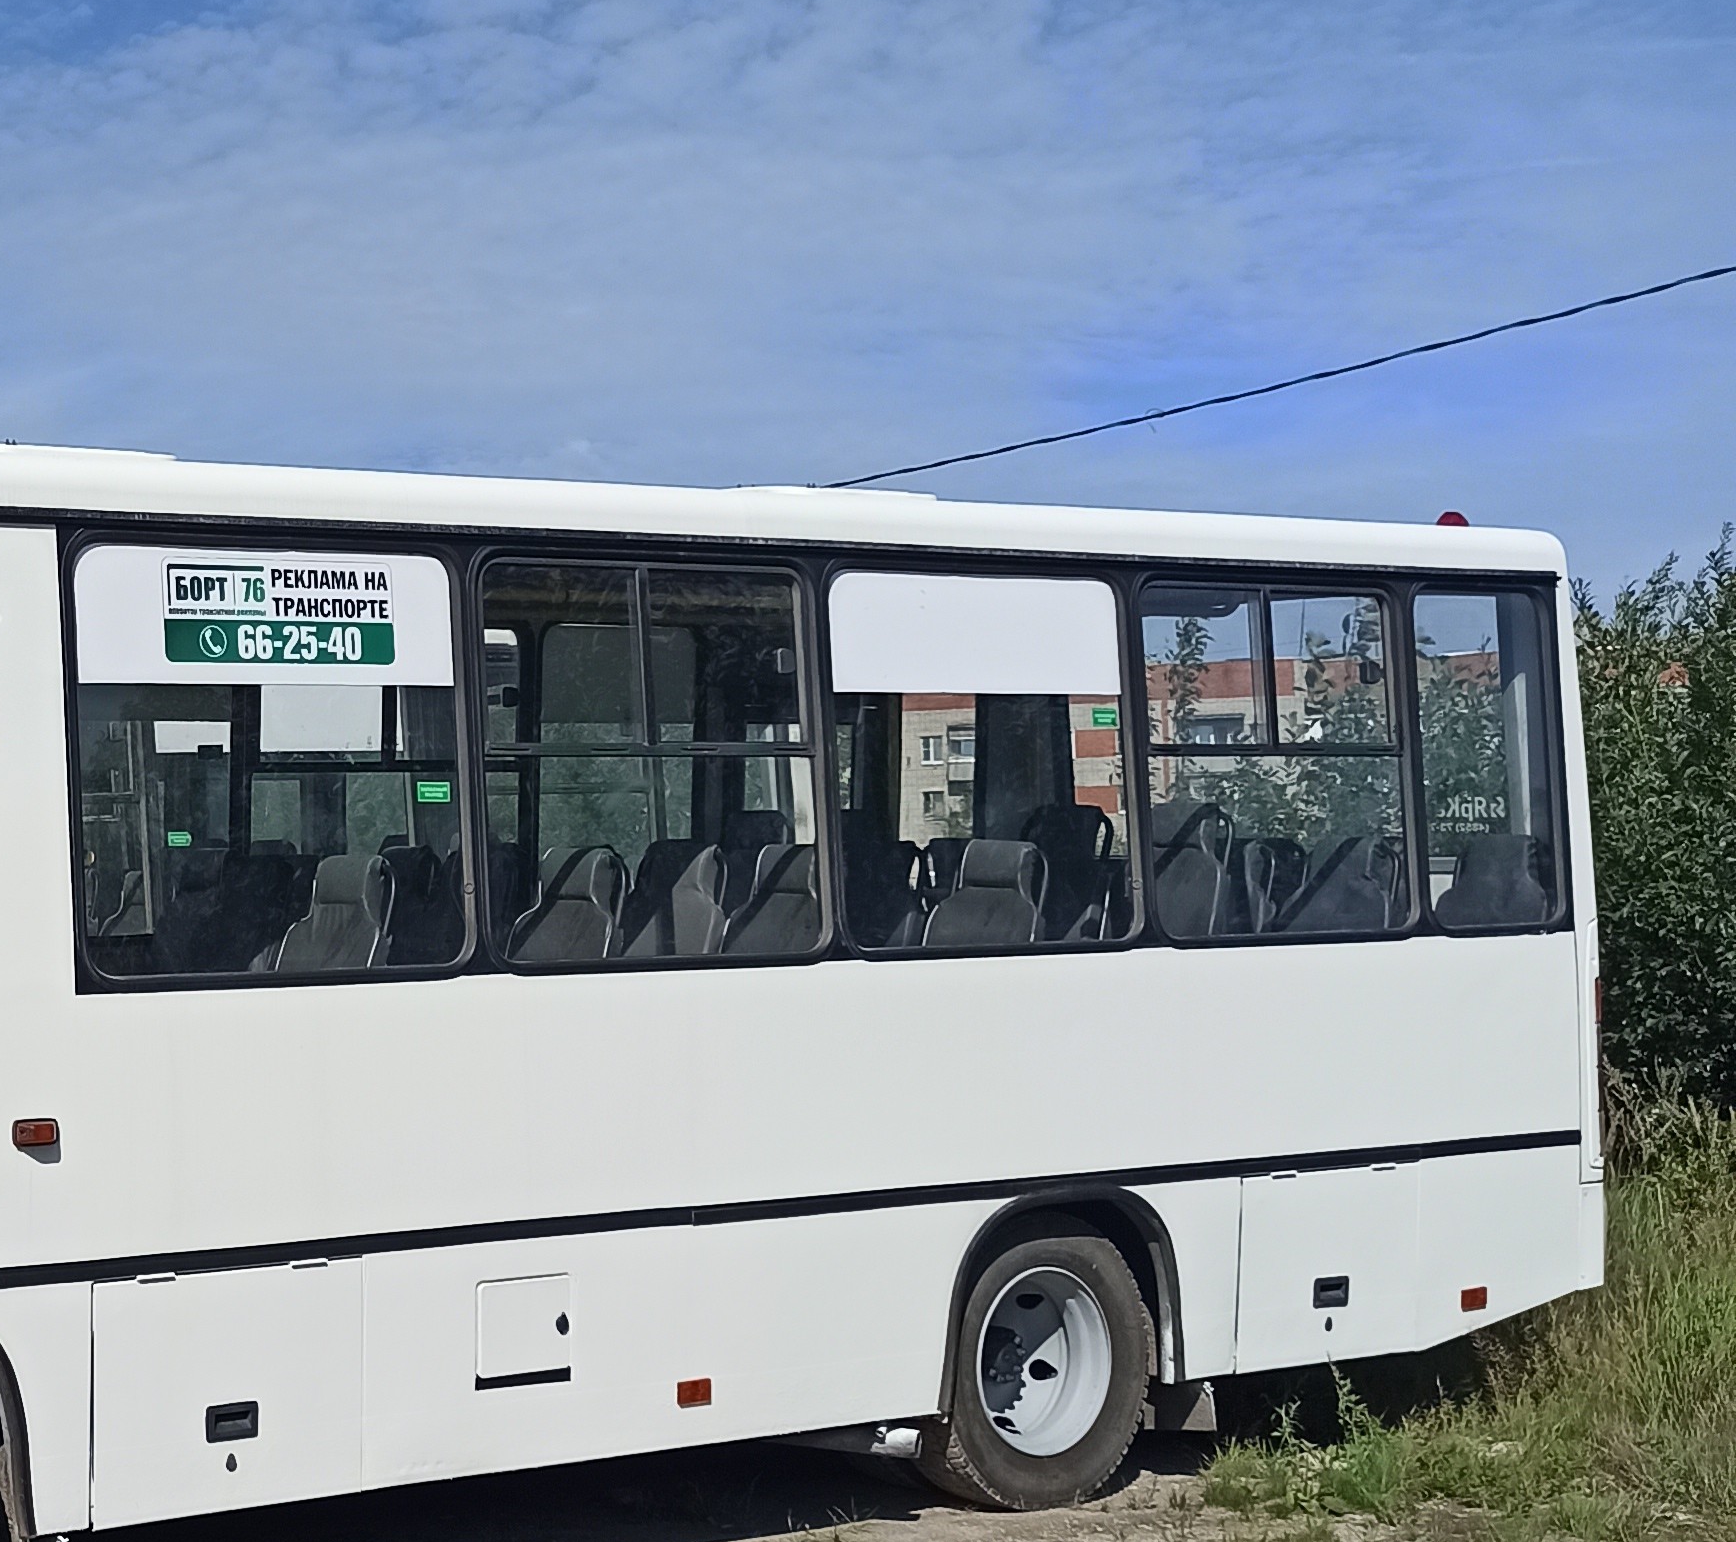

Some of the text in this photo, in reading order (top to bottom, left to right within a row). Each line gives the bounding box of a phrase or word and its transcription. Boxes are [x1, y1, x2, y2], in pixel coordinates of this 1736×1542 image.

[175, 575, 266, 603] БОРТ 76
[270, 569, 388, 591] РЕКЛАМА НА
[271, 597, 389, 619] ТРАНСПОРТЕ
[237, 624, 362, 662] 66-25-40
